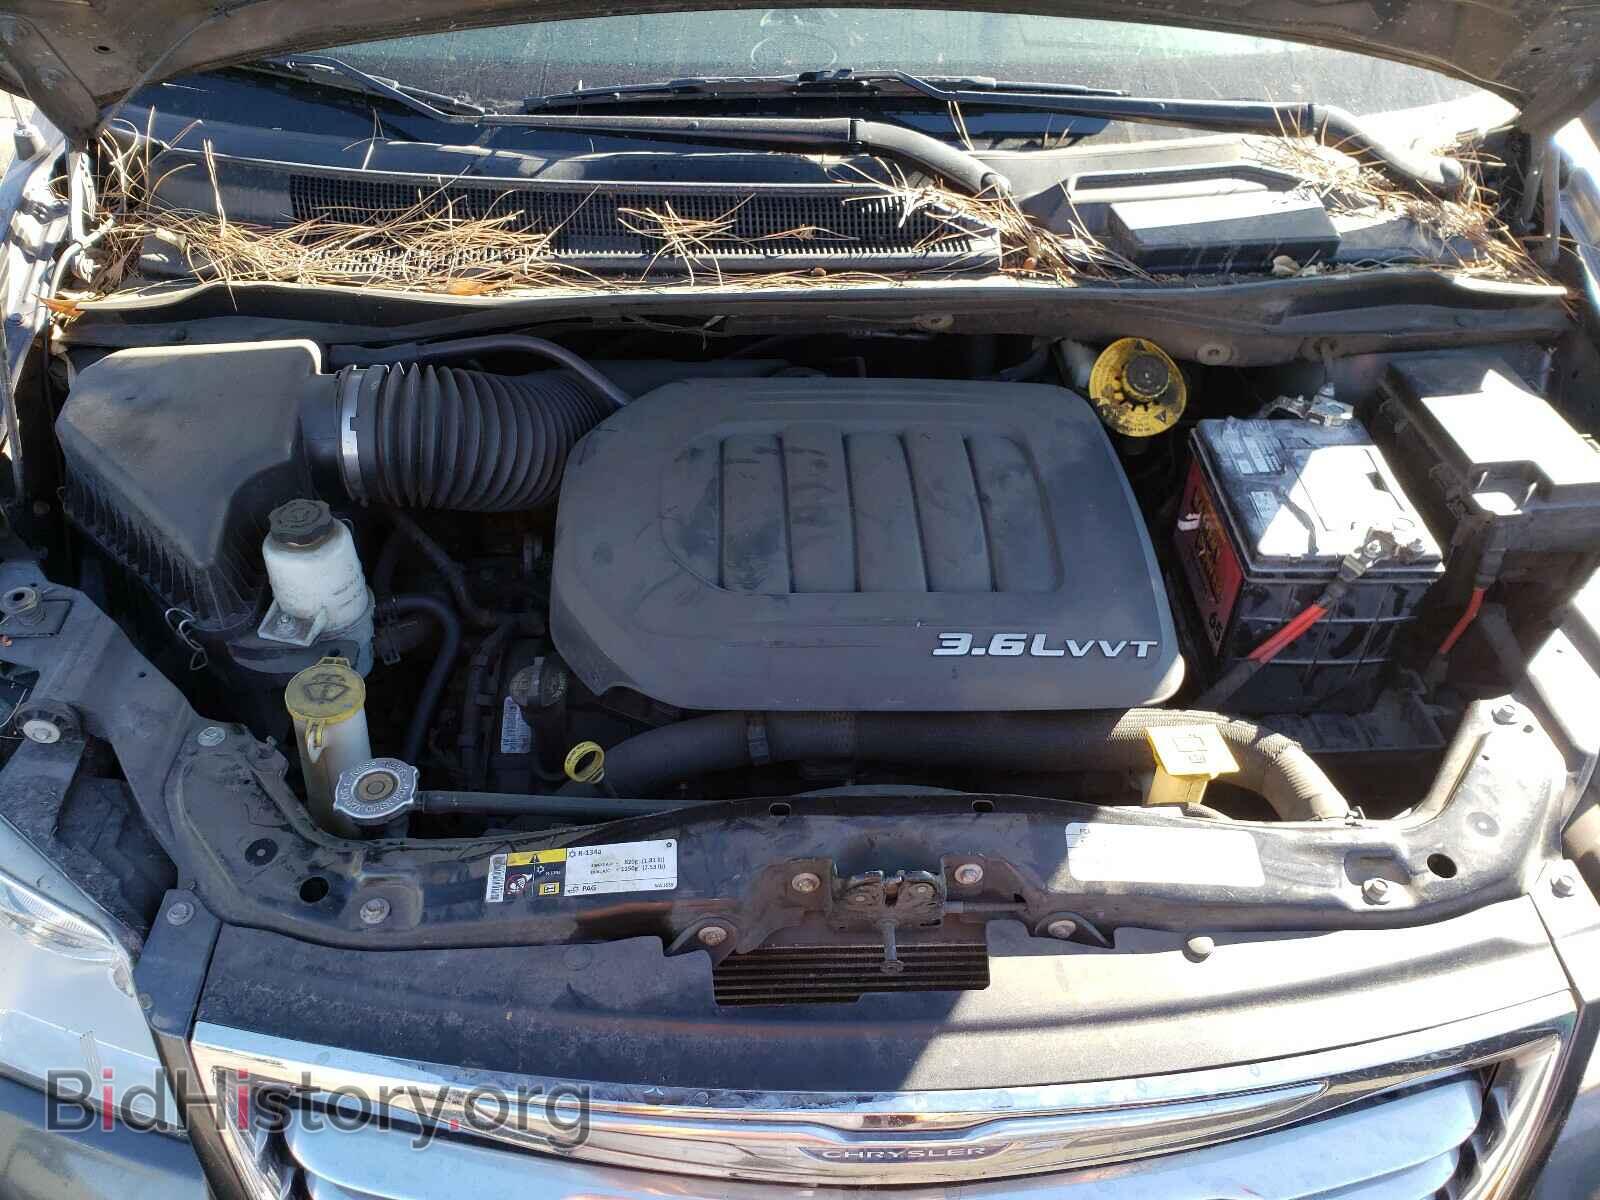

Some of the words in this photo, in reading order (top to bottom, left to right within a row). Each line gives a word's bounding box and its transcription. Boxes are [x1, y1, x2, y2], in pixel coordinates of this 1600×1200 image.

[931, 631, 1065, 657] 3.6L
[1065, 639, 1158, 658] VVT
[578, 849, 602, 857] R-134a
[582, 885, 597, 893] PAG
[822, 1146, 986, 1159] CHRYSLER
